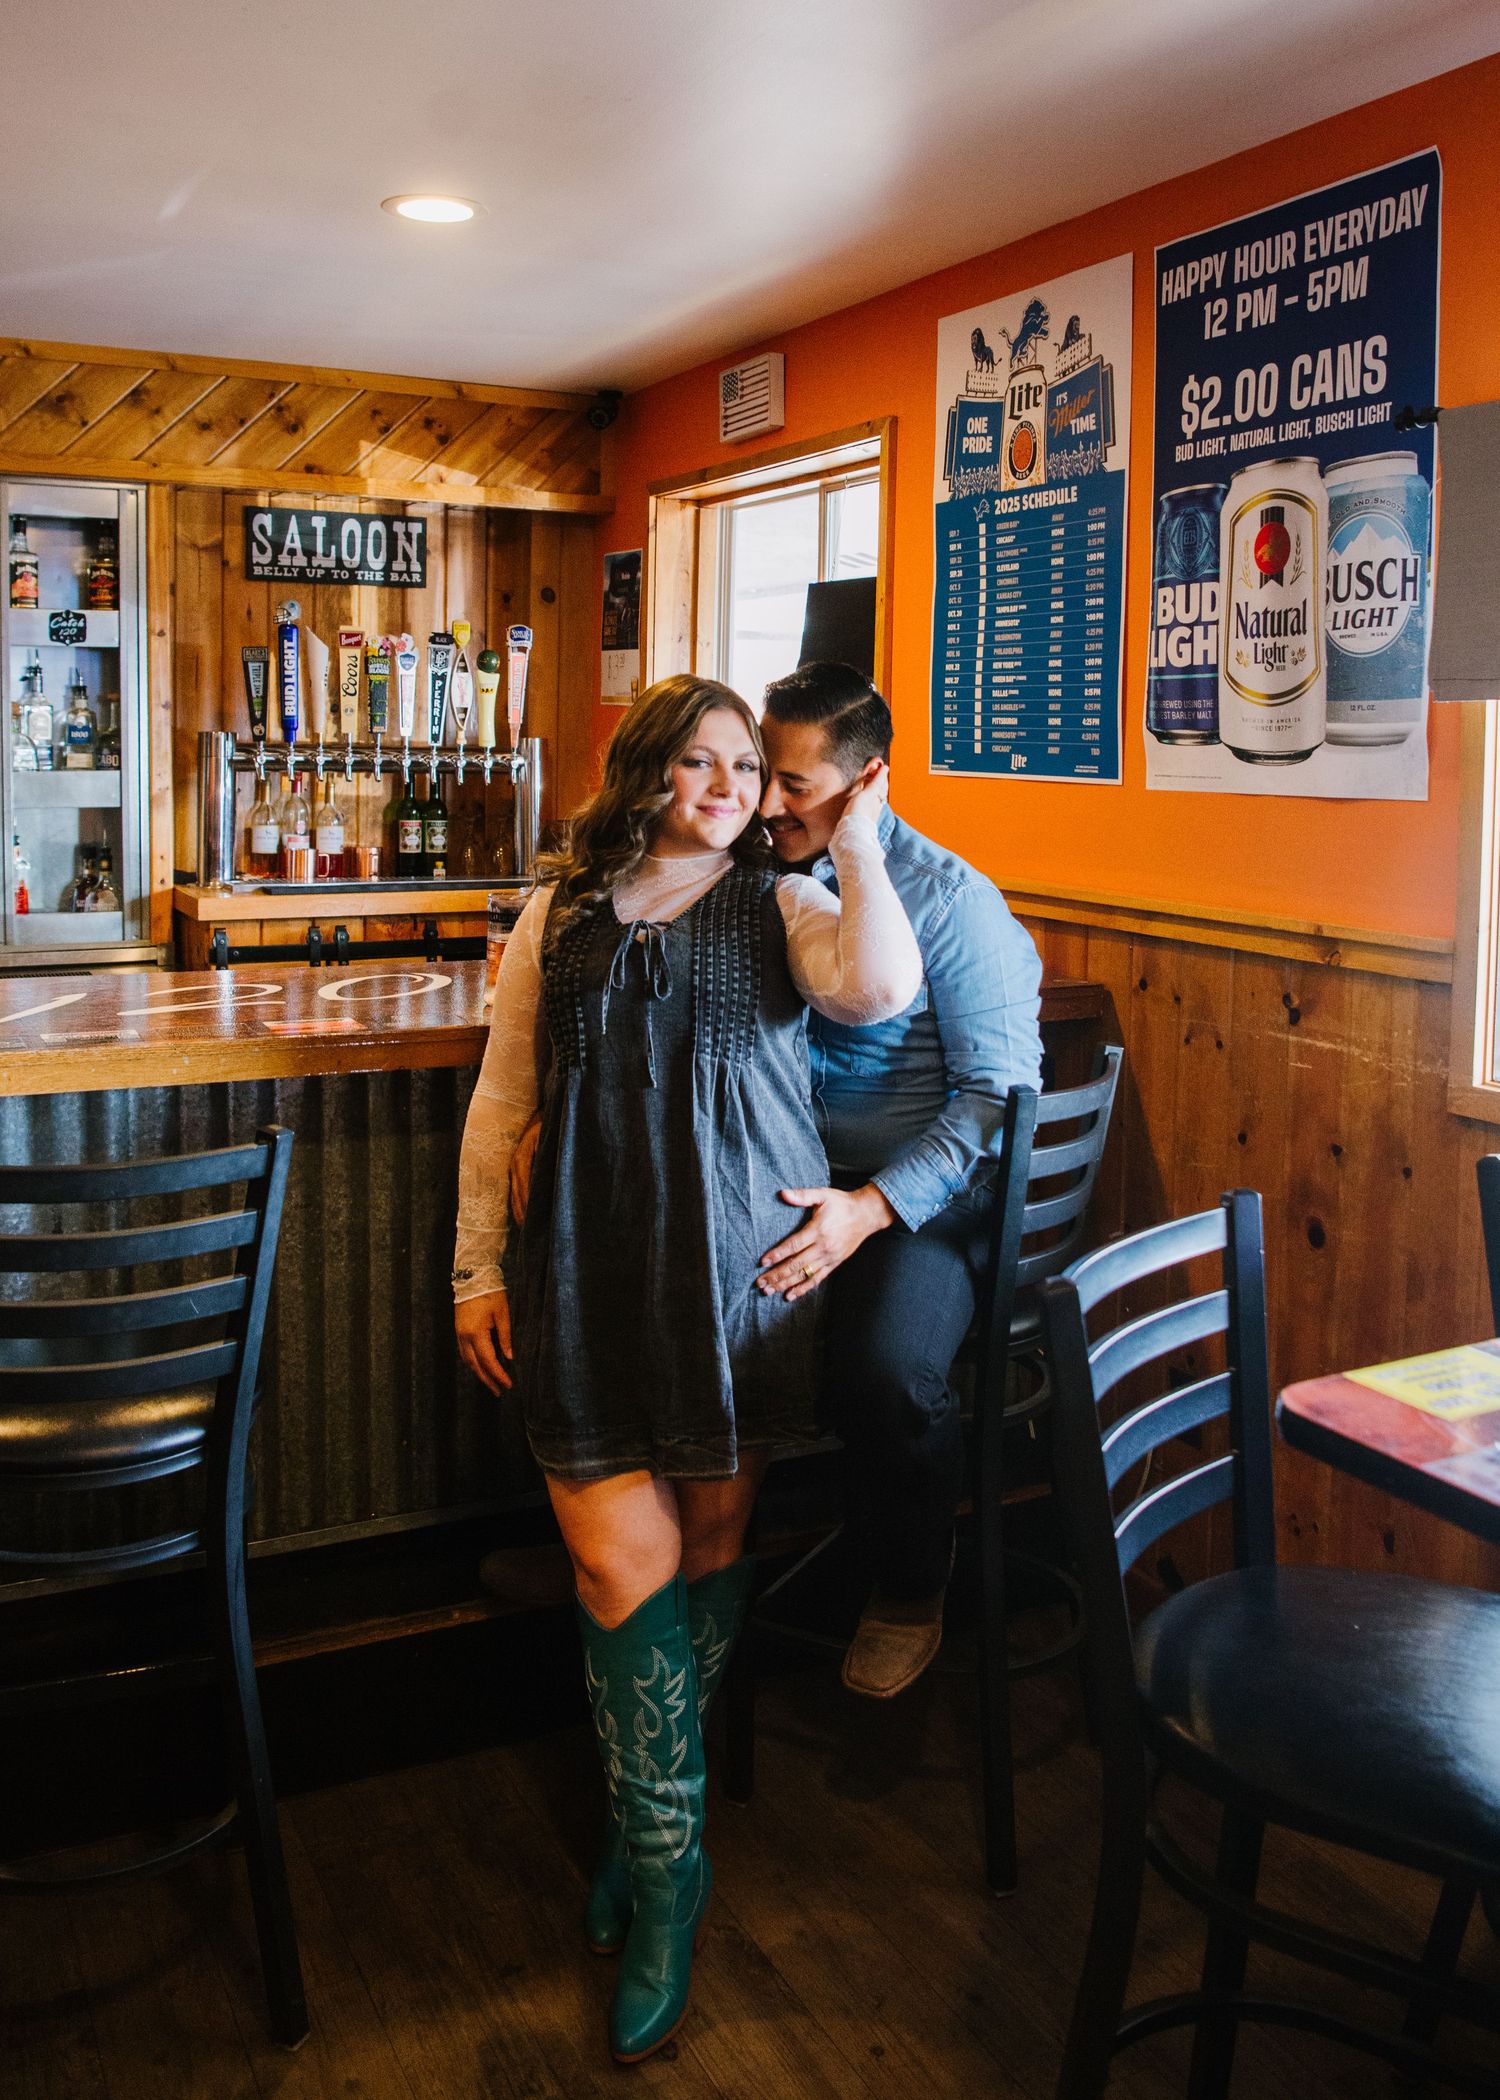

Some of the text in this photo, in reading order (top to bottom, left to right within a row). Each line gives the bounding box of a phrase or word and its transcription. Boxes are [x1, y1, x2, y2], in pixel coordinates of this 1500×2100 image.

[1161, 183, 1428, 306] HAPPY HOUR EVERYDAY
[1204, 298, 1228, 340] 12
[1236, 284, 1278, 333] PM
[1306, 255, 1370, 312] 5PM
[1181, 334, 1388, 440] $2.00 CANS
[1008, 382, 1042, 420] Lite
[1048, 388, 1096, 438] Miller
[967, 416, 988, 434] ONE
[1070, 412, 1096, 435] TIME
[1175, 402, 1392, 462] BUD LIGHT, NATURAL LIGHT, BUSCH LIGHT
[962, 436, 993, 454] PRIDE
[994, 485, 1078, 515] 2025 SCHEDULE
[1354, 498, 1370, 508] AND
[1374, 498, 1406, 515] SMOOTH
[1051, 528, 1064, 536] HOME
[1098, 522, 1105, 530] PM
[252, 512, 422, 572] SALOON
[253, 566, 422, 582] BELLY UP TO THE BAR
[996, 563, 1019, 573] CLEVELAND
[1051, 557, 1064, 566] HOME
[1097, 552, 1104, 560] PM
[1051, 601, 1064, 609] HOME
[1156, 582, 1219, 626] BUD
[50, 616, 84, 628] Catch
[1050, 616, 1064, 624] HOME
[1236, 598, 1307, 640] Natural
[1332, 606, 1398, 631] LIGHT
[1150, 624, 1217, 668] LIGH
[1254, 641, 1287, 672] Light
[342, 654, 358, 697] Coors
[1048, 659, 1062, 667] HOME
[284, 639, 296, 716] BUD LIGHT
[1094, 688, 1100, 696] PM
[1202, 700, 1214, 708] THE
[432, 680, 443, 734] PERRIN
[1171, 711, 1195, 720] BARLEY
[1010, 754, 1027, 770] Lite
